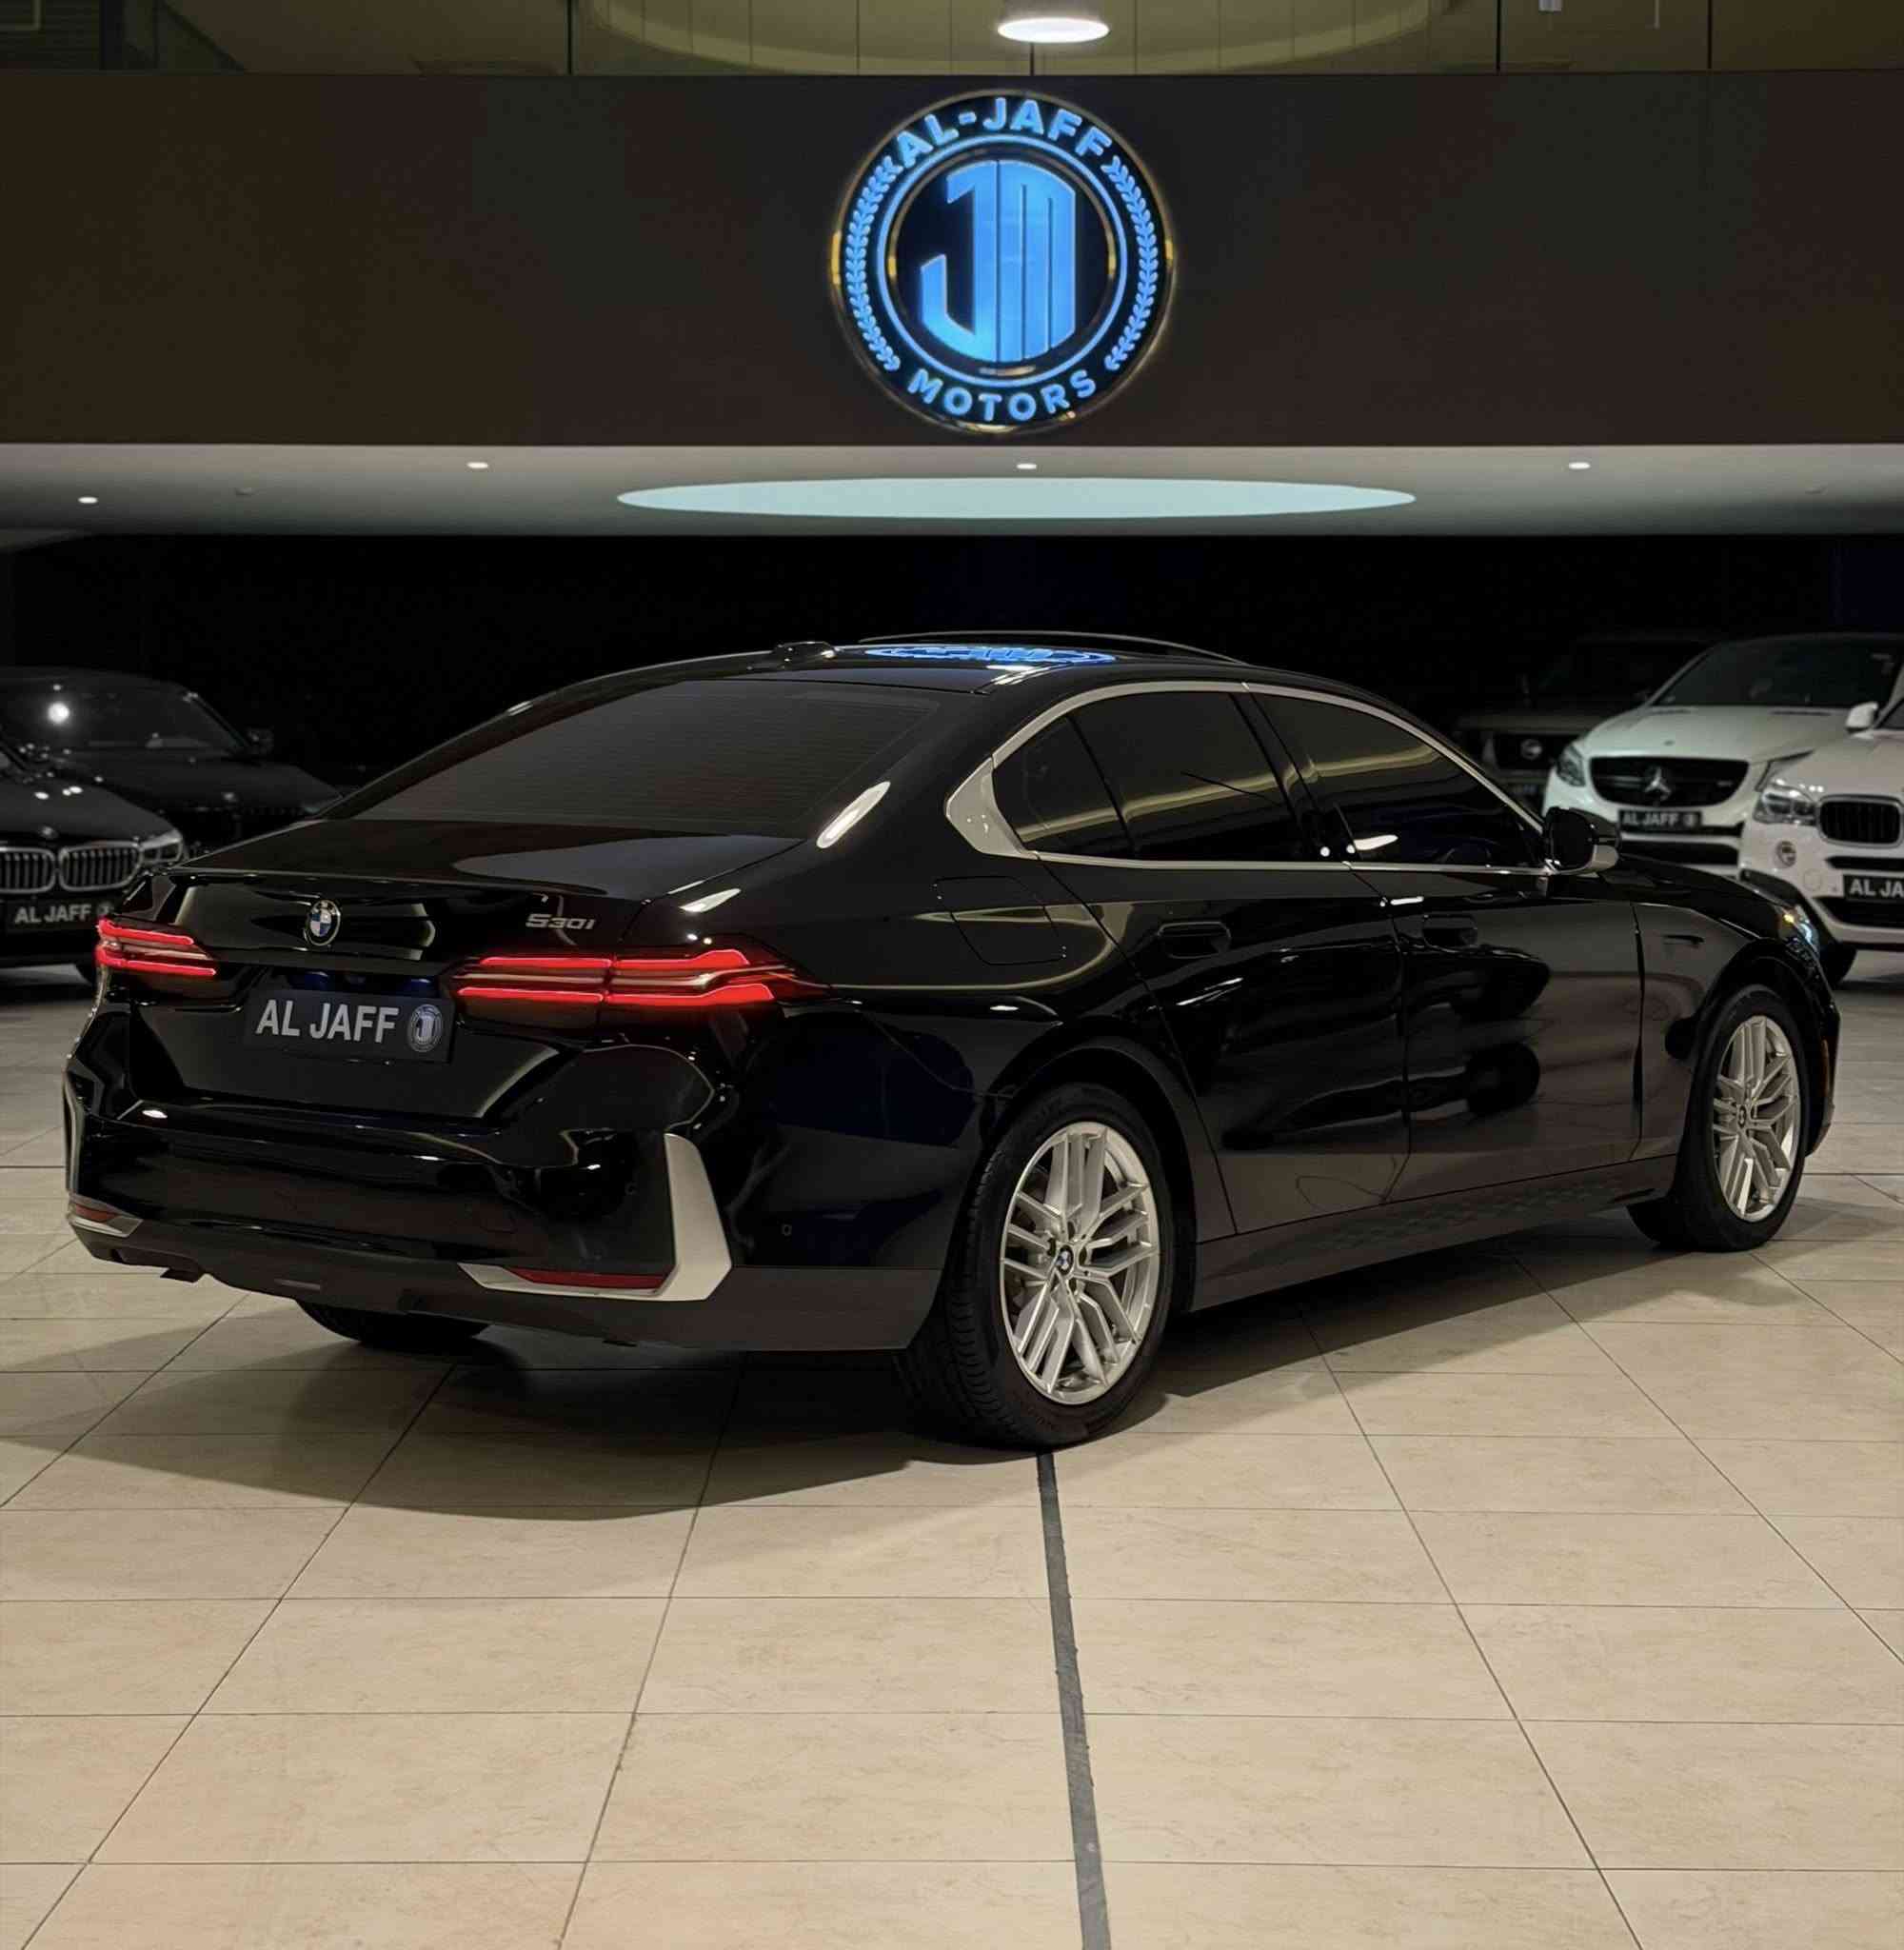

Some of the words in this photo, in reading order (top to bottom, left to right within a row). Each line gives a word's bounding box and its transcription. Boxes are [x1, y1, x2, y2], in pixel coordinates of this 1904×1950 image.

[896, 97, 1112, 169] AL-JAFF
[907, 368, 1096, 422] MOTORS
[1622, 812, 1638, 826] AL
[1849, 879, 1876, 896] AL
[15, 906, 42, 924] AL
[44, 904, 91, 922] JAFF
[255, 999, 301, 1037] AL
[308, 1003, 400, 1044] JAFF
